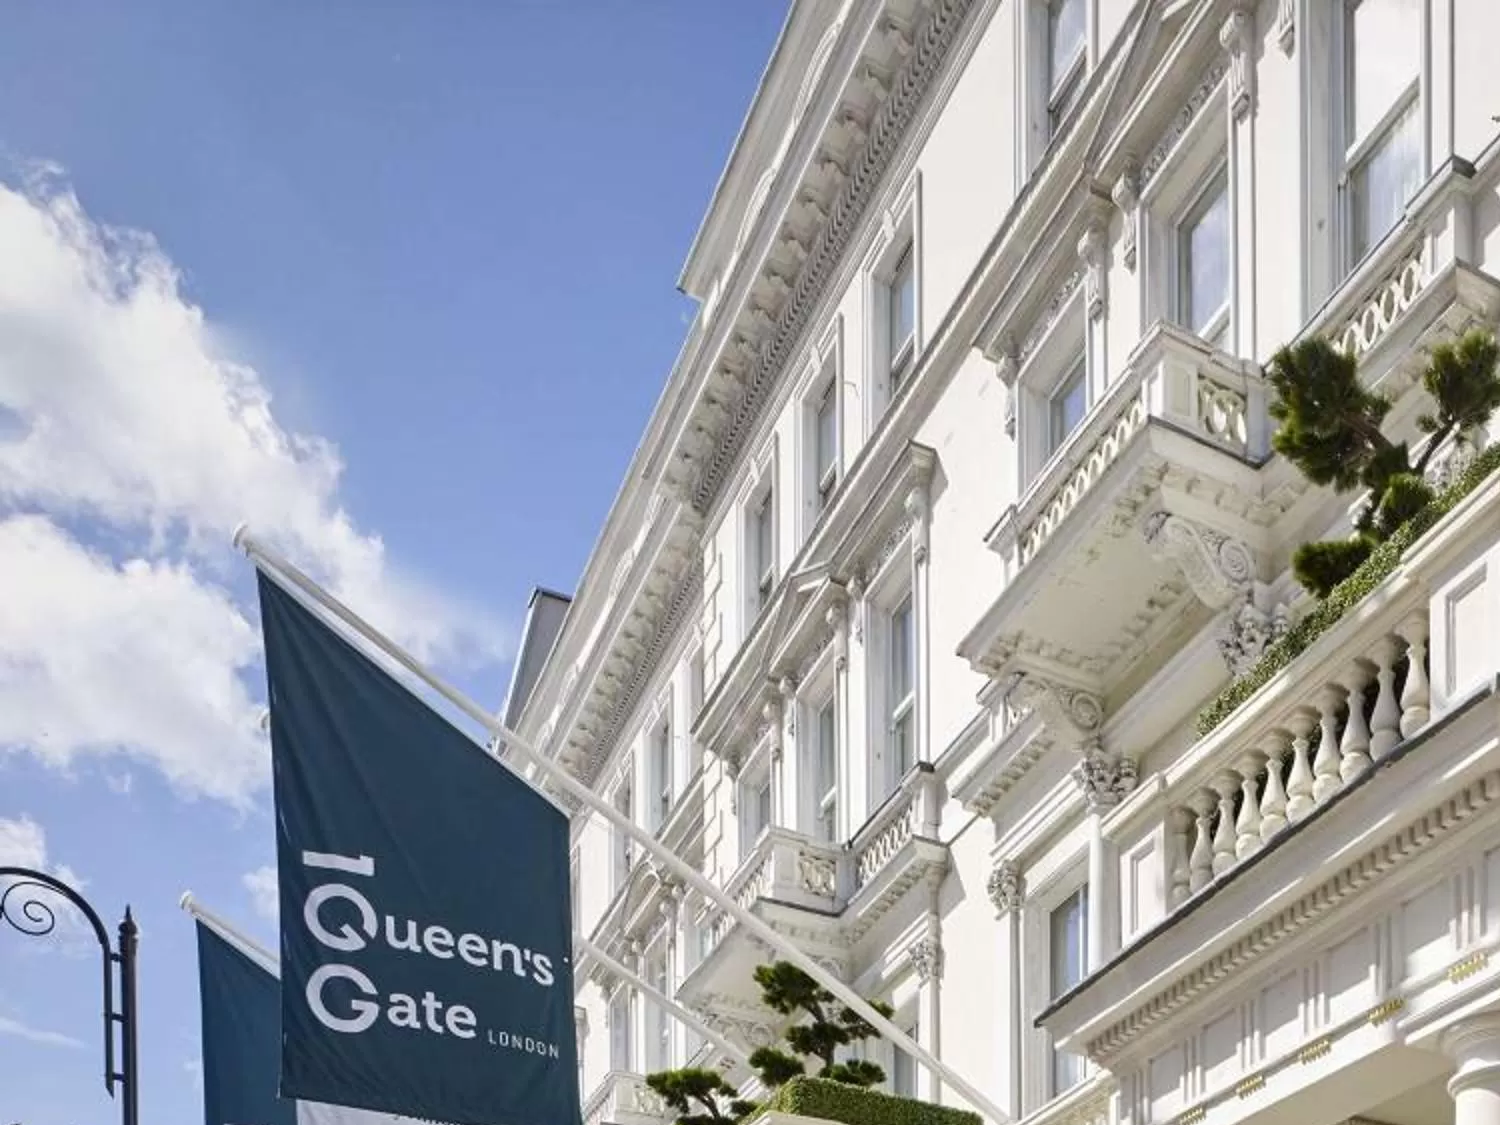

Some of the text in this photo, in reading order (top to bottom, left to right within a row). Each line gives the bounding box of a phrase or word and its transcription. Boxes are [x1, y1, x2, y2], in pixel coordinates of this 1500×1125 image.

[303, 883, 555, 986] Queen's
[305, 963, 560, 1060] Gate LONDON
